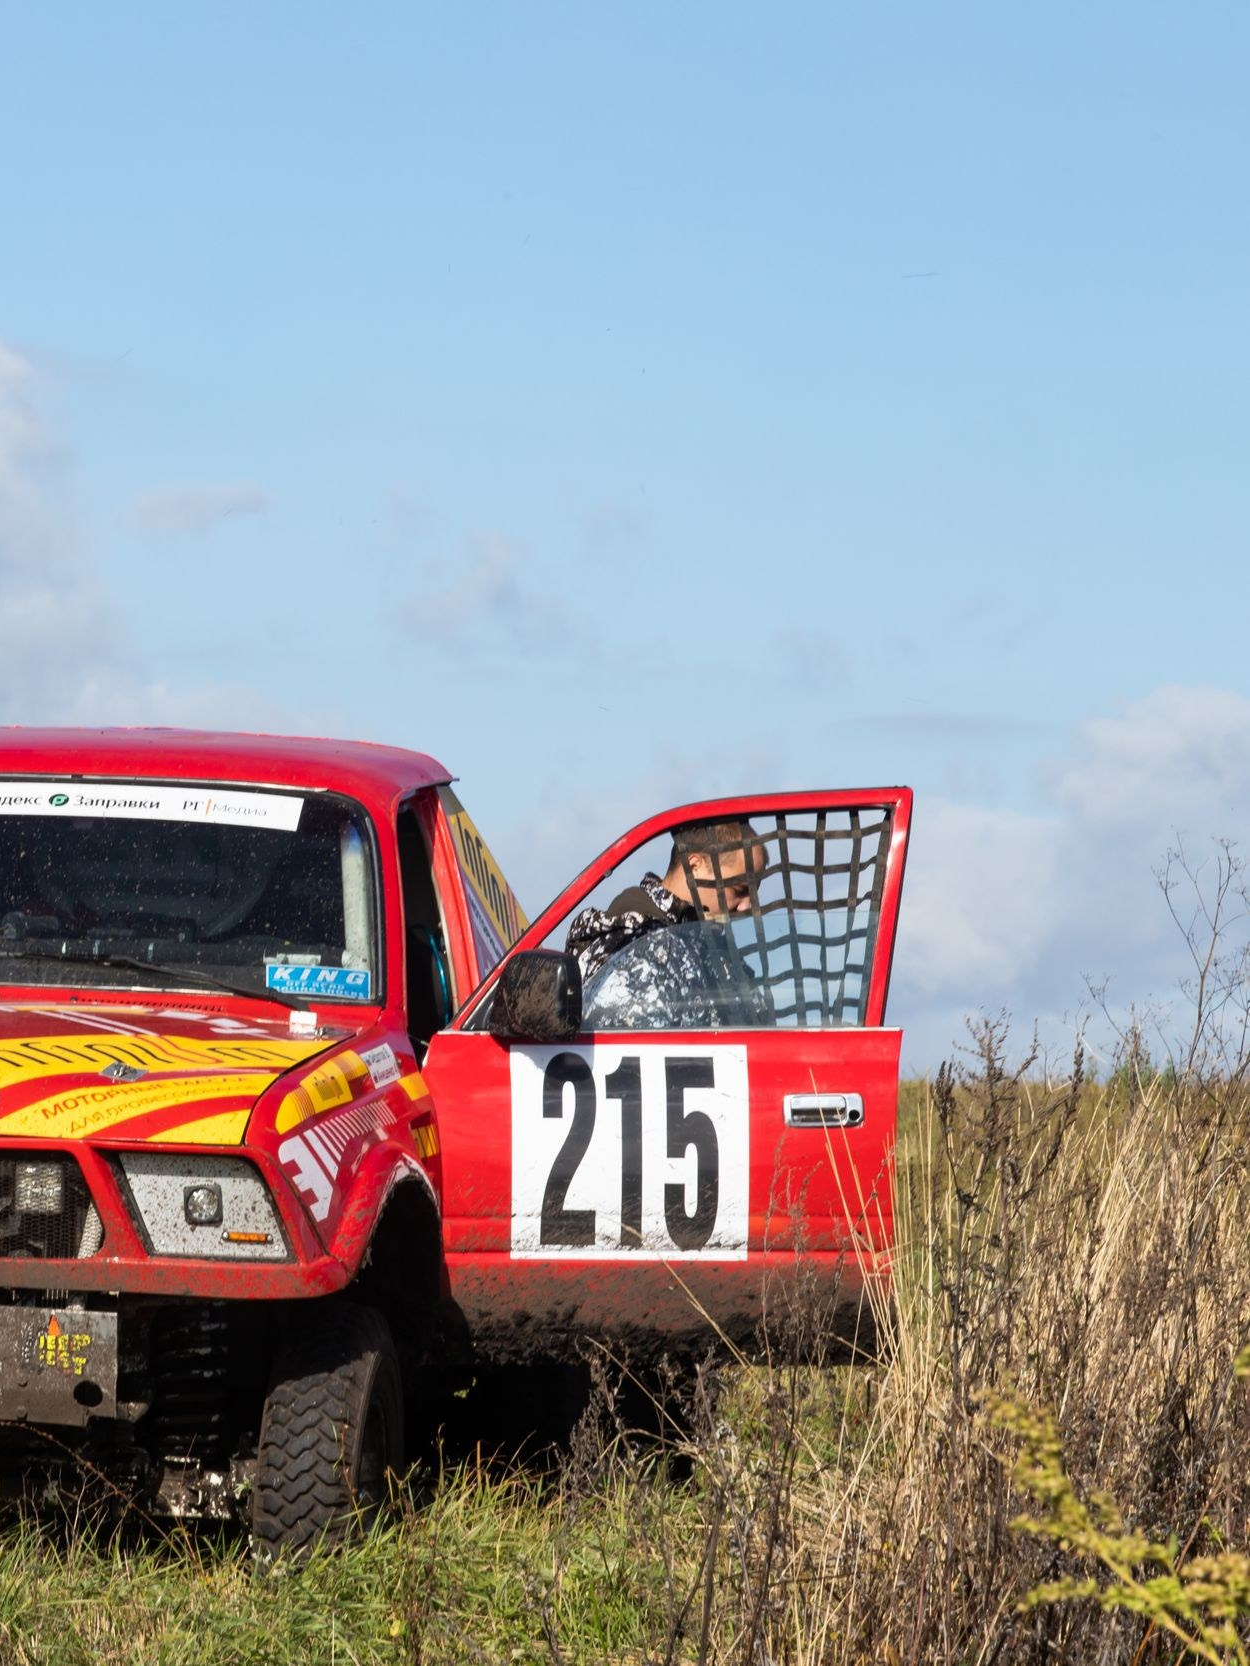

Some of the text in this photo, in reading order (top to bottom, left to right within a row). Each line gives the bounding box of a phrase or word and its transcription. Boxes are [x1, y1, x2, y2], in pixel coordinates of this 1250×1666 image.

[74, 794, 160, 809] Заправки
[213, 803, 267, 817] Медиа
[273, 967, 366, 985] KING
[41, 1082, 166, 1120] МОТОРНЫЕ
[540, 1052, 720, 1252] 215
